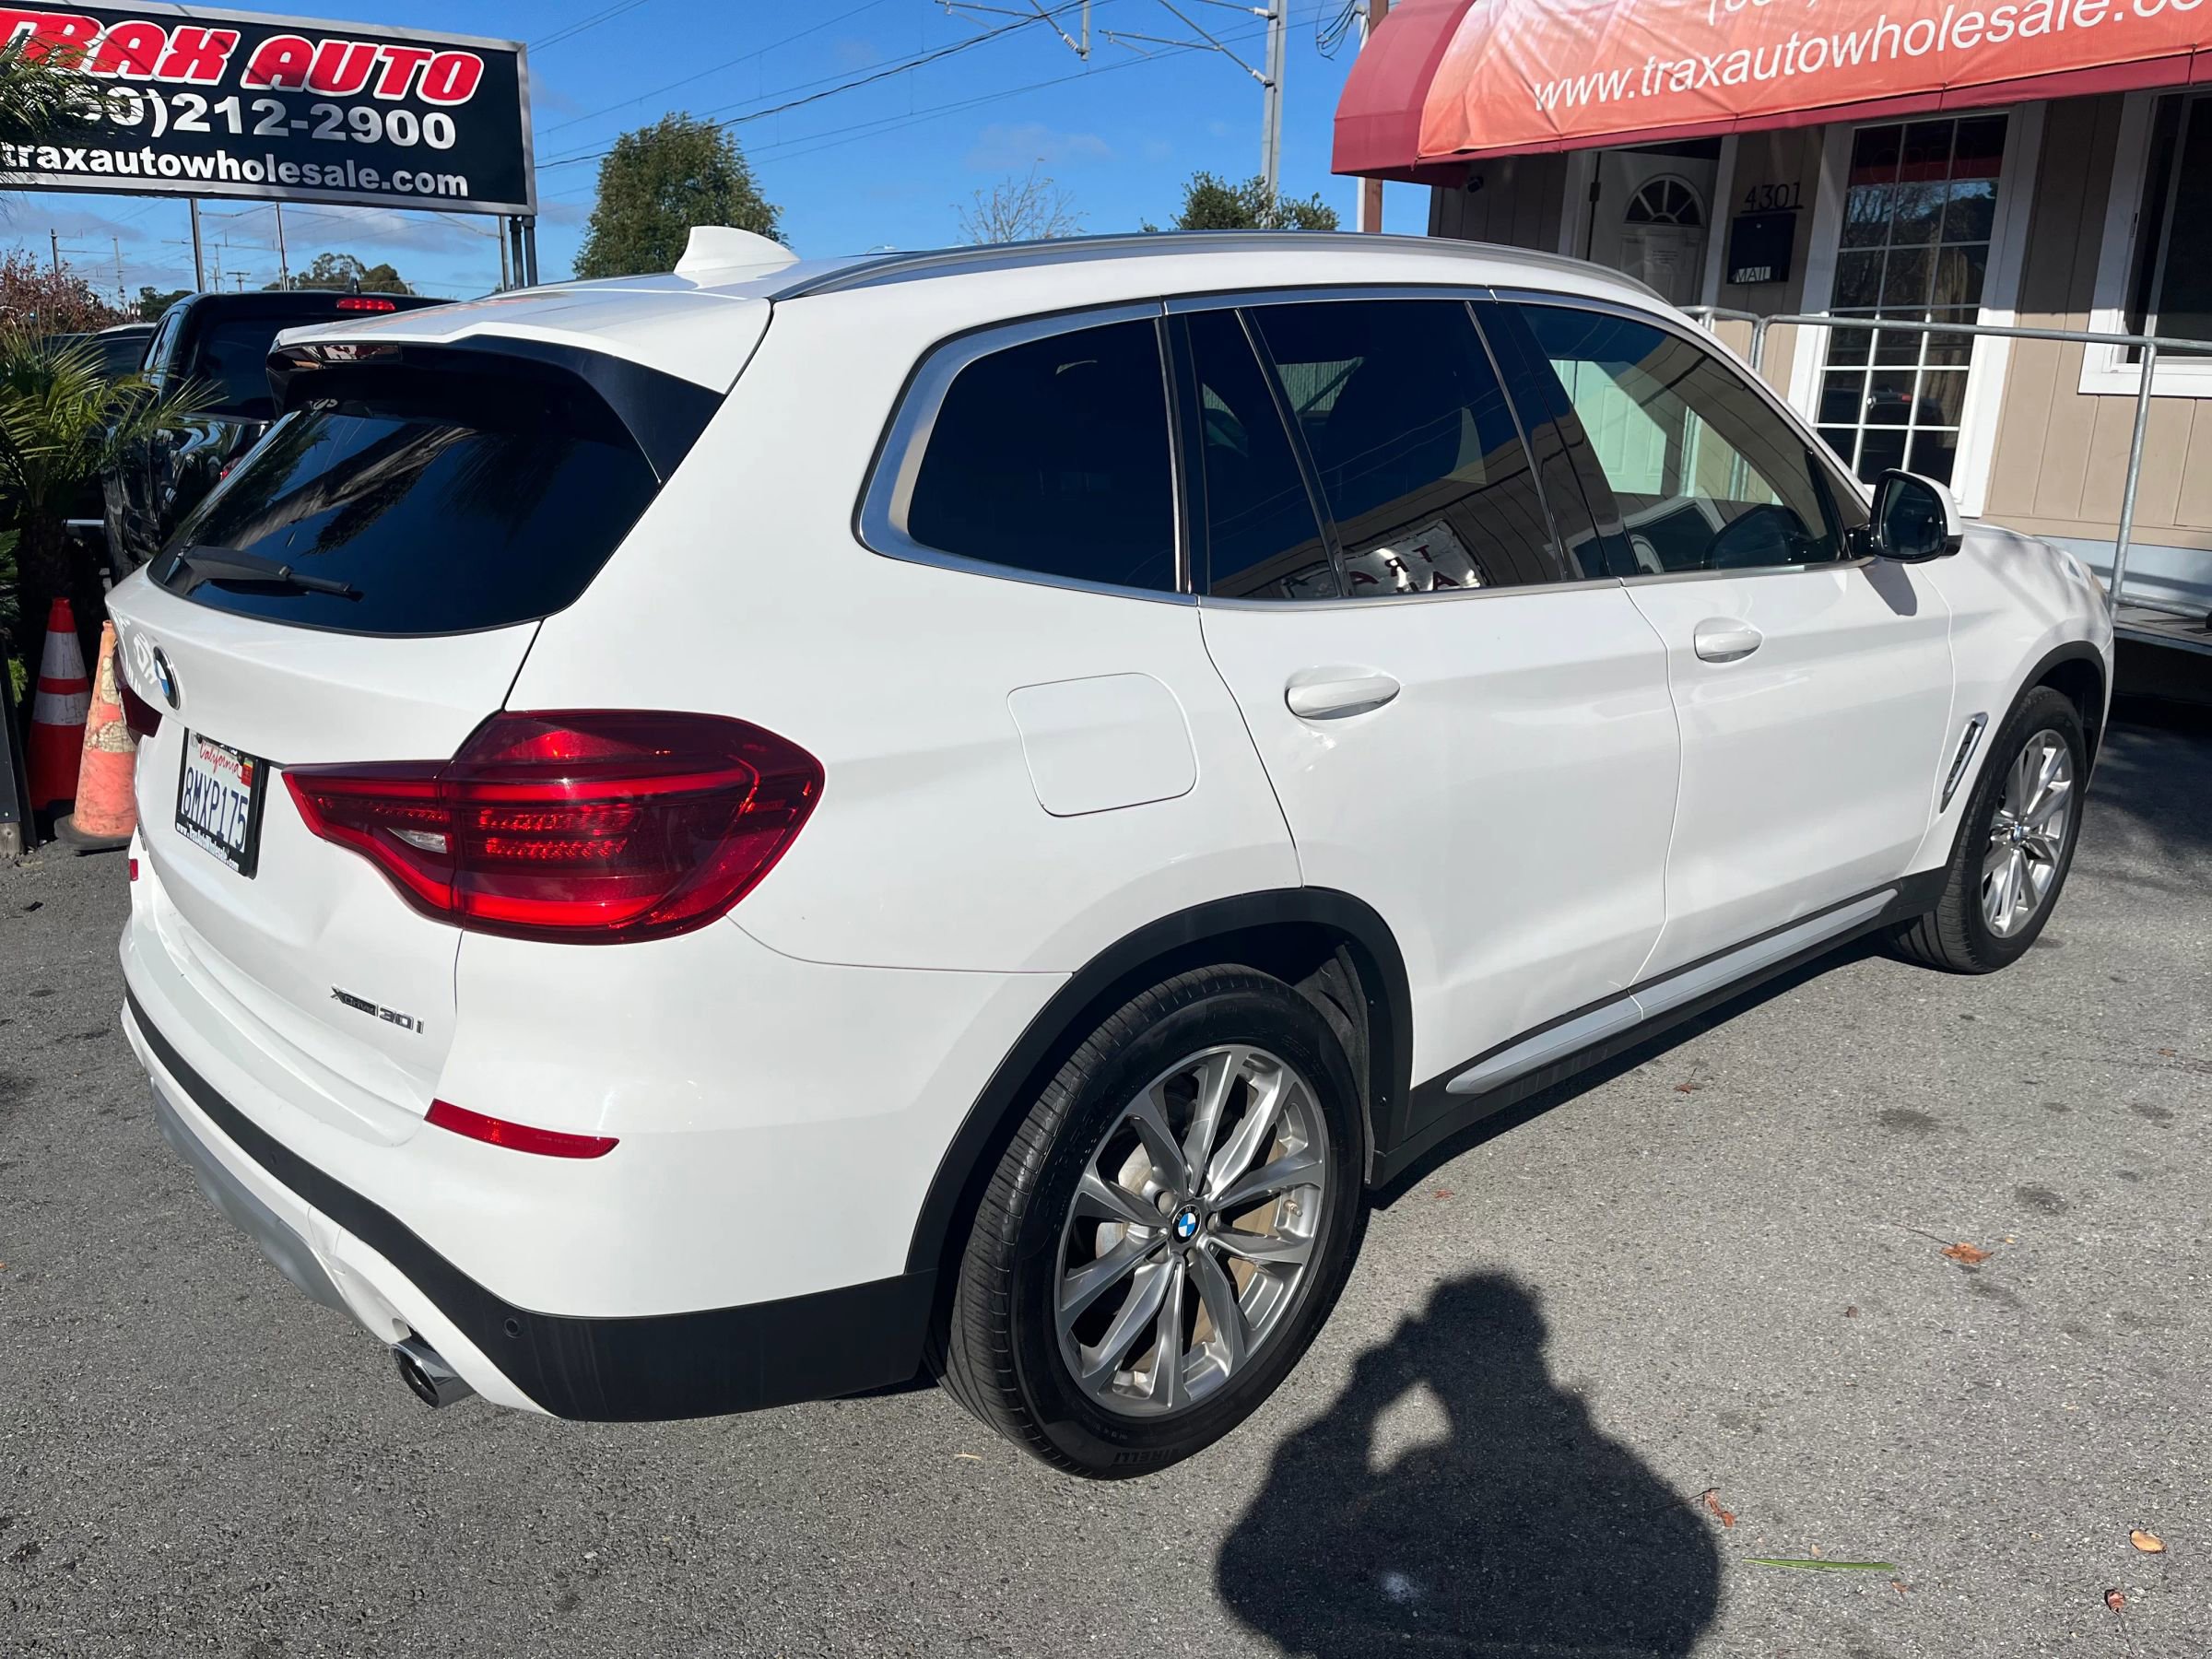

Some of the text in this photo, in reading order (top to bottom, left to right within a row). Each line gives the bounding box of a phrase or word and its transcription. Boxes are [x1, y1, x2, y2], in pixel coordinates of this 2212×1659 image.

[0, 7, 484, 105] TRAX AUTO
[1534, 0, 2212, 112] www.traxautowholesale.
[1744, 182, 1803, 212] 4301
[1734, 266, 1771, 284] MAIL
[200, 743, 240, 774] California
[181, 766, 248, 850] 8MXP175
